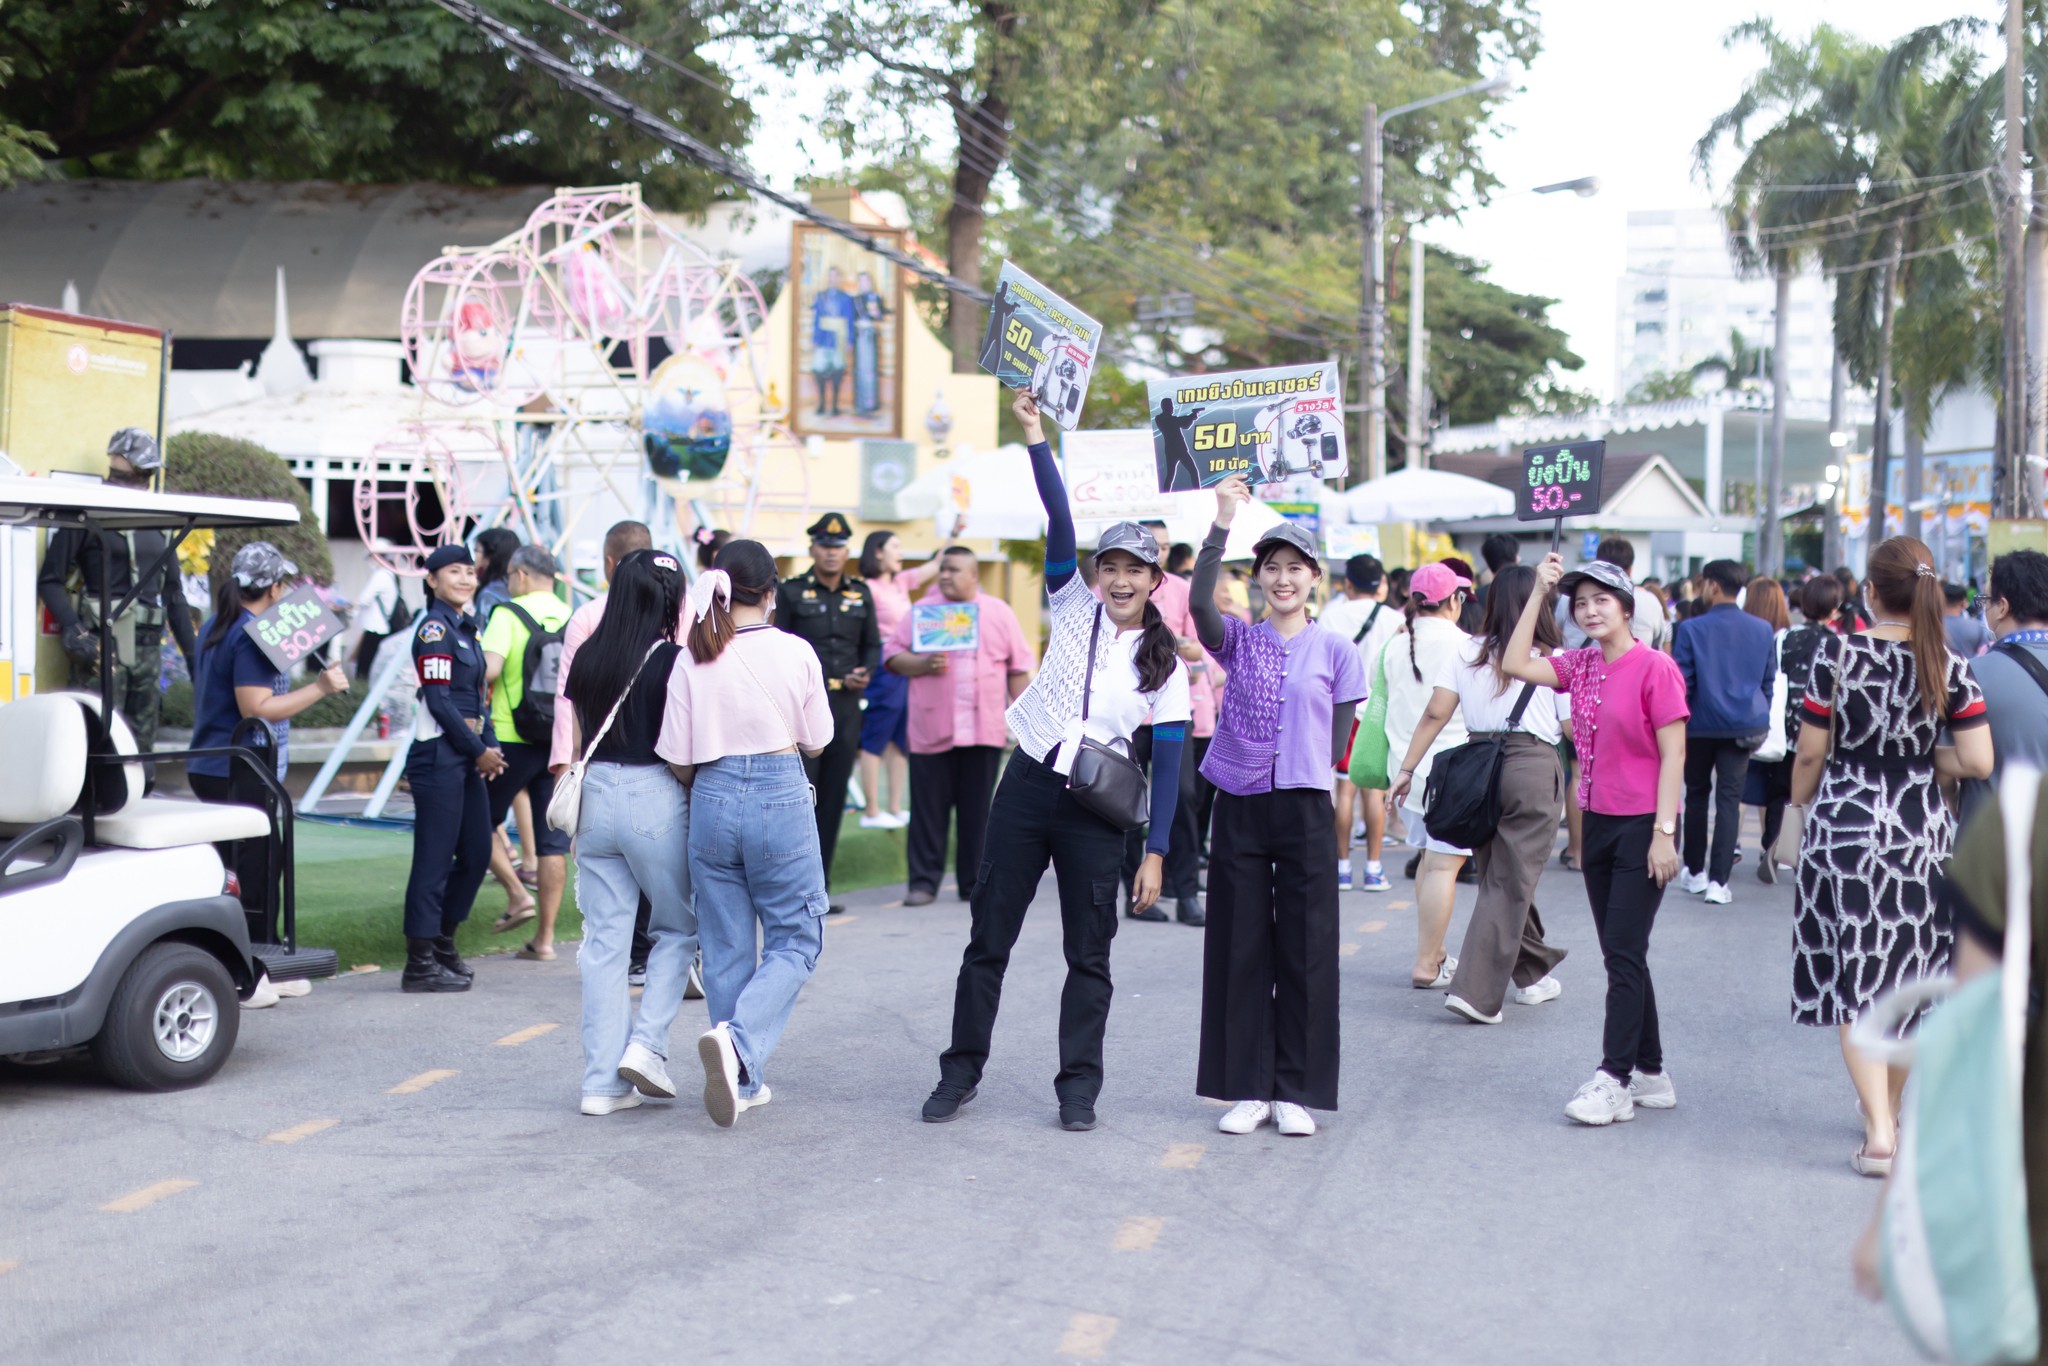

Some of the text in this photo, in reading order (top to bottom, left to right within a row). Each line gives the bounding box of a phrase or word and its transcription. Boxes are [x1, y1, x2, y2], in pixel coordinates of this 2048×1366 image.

[1010, 280, 1092, 344] SHOOTING LASER GUN
[1005, 318, 1049, 367] 50 BAHT
[1003, 350, 1034, 378] 10 SHOTS
[1176, 370, 1323, 404] เกมยิงปืนเลเซอร์
[1297, 400, 1330, 412] รางวัล
[1192, 421, 1272, 452] 50 บาท
[1208, 456, 1249, 473] 10 นัด
[1531, 485, 1582, 513] 50.-
[423, 656, 451, 681] สห
